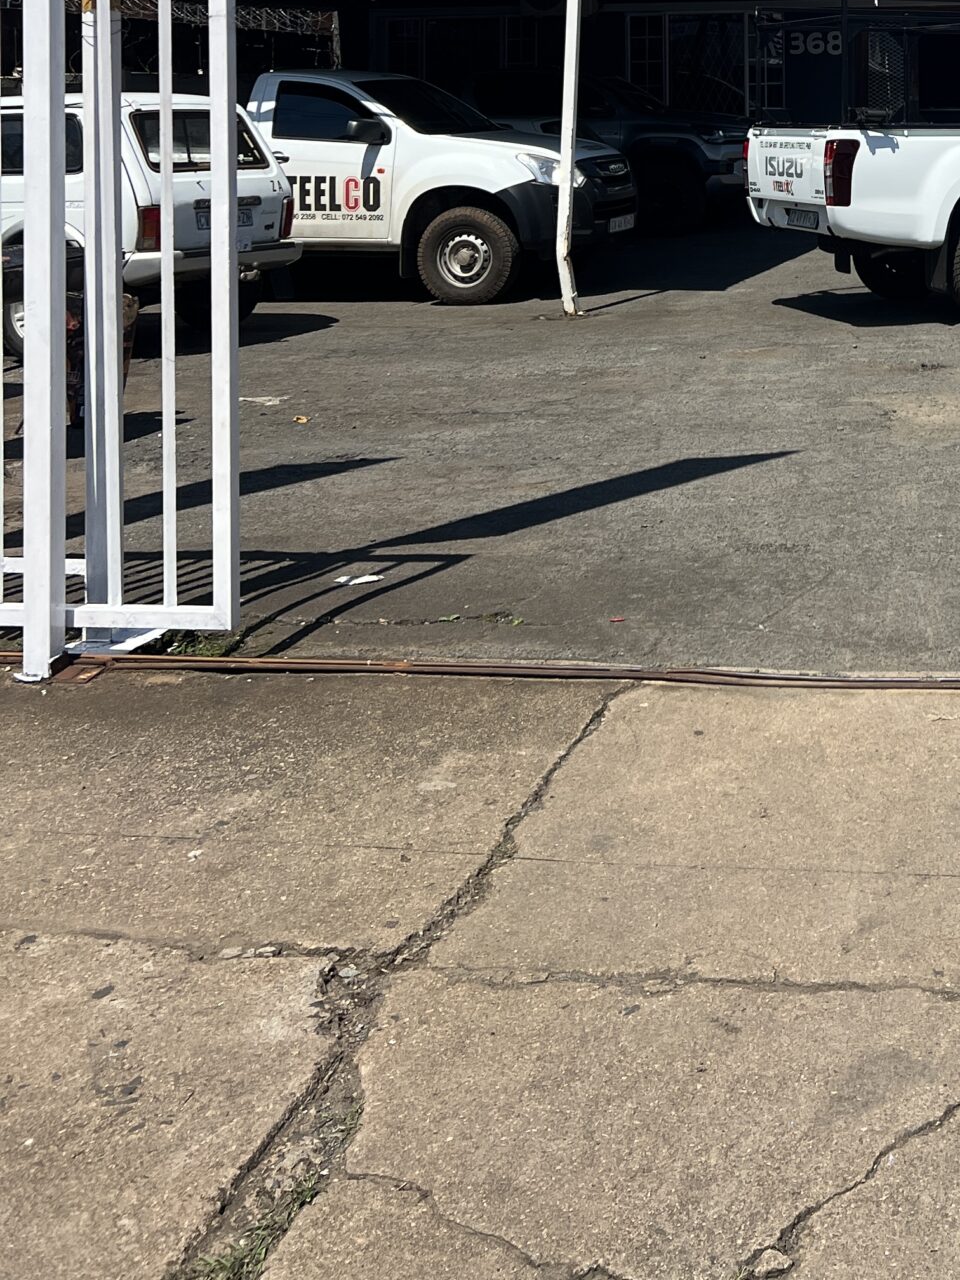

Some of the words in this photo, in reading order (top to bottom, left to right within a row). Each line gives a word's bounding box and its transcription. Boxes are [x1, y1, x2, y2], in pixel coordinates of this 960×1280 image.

[789, 31, 842, 55] 368
[765, 156, 803, 178] ISUZU
[287, 176, 381, 212] TEELCO
